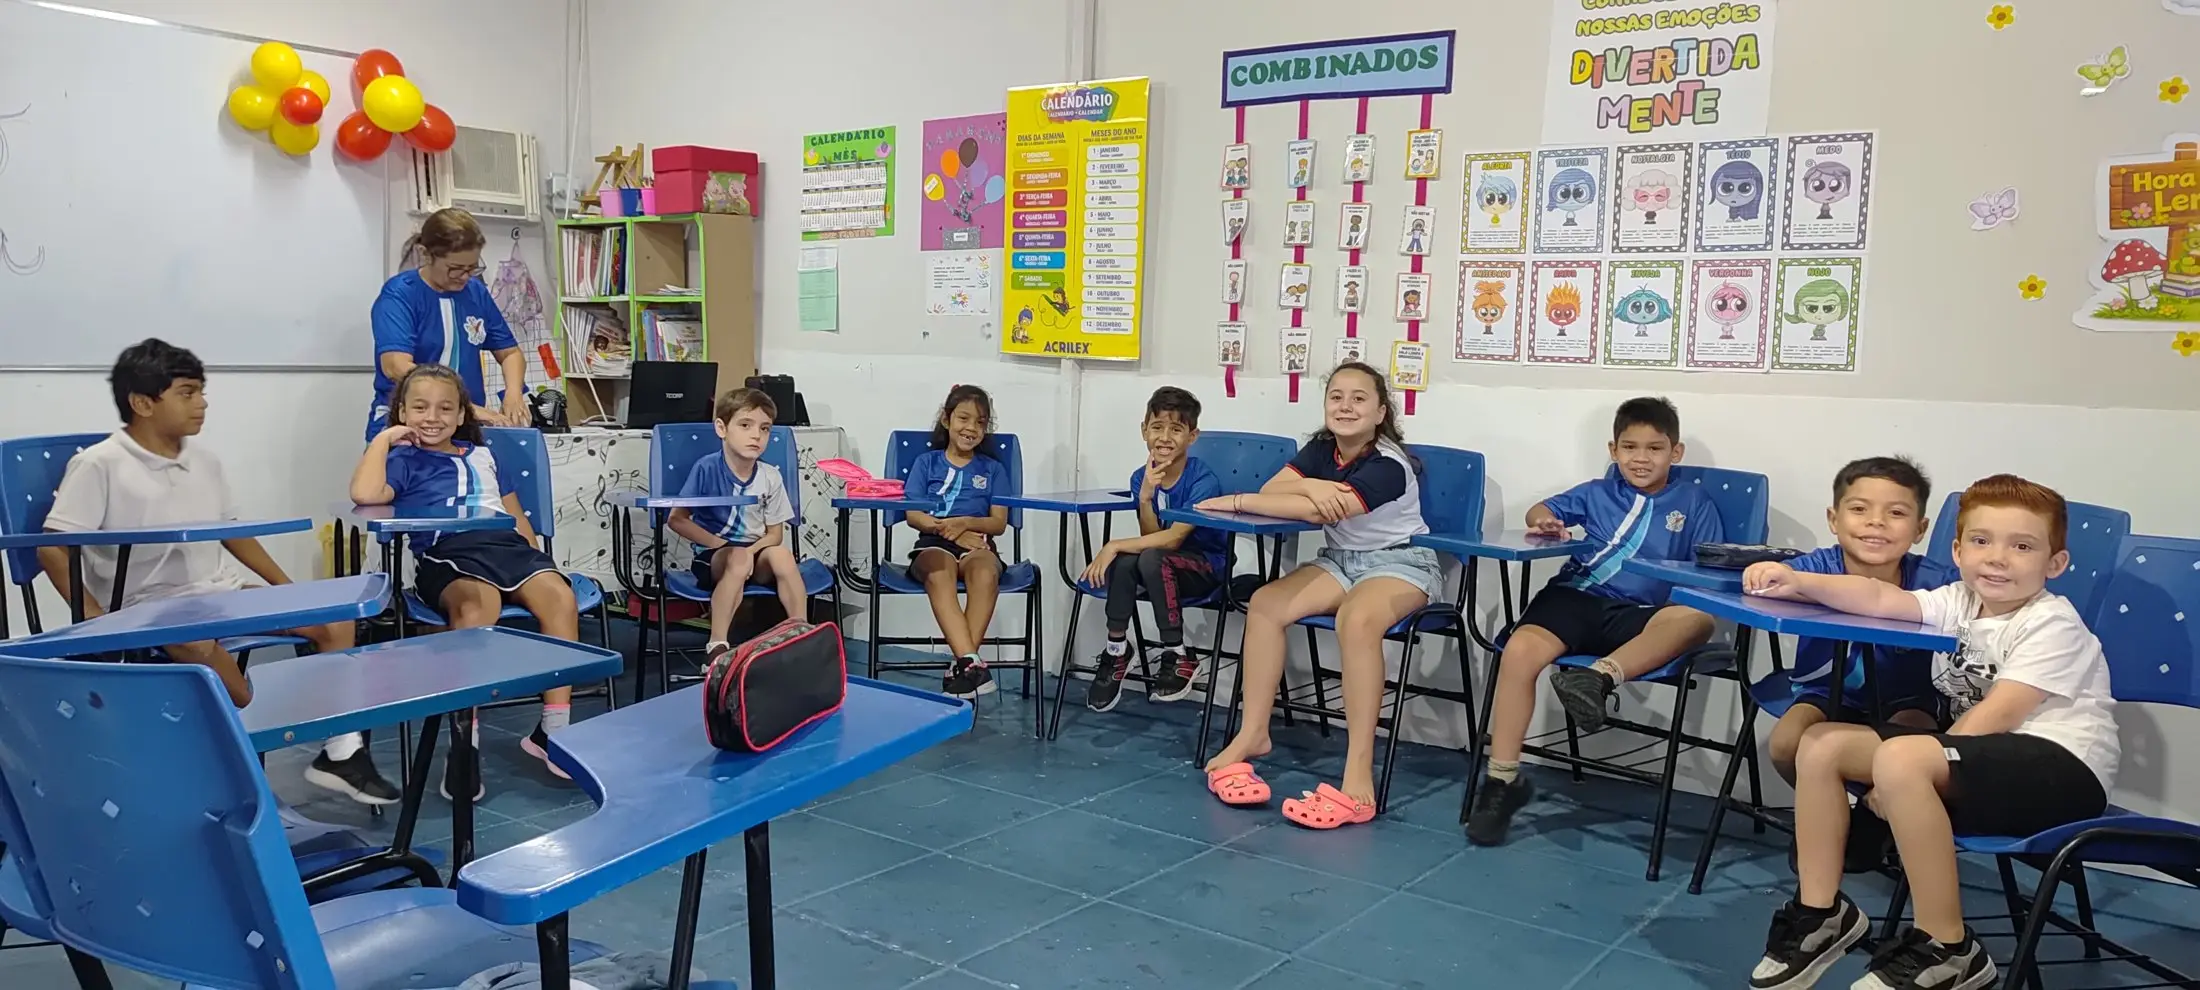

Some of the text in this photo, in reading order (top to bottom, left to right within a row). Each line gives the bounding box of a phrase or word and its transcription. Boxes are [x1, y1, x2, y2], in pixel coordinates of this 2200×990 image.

[1576, 4, 1760, 37] NOSSAS EMOÇÕES
[1230, 44, 1439, 87] COMBINADOS
[1570, 33, 1760, 89] DIVERTIDA
[1041, 91, 1113, 111] CALENDÁRIO
[1597, 80, 1721, 133] MENTE
[1078, 108, 1103, 116] CALENDAR
[1017, 132, 1065, 142] DIAS DA SEMANA
[1091, 127, 1137, 137] MESES DO ANO
[811, 129, 885, 147] CALENDÁRIO
[1726, 149, 1751, 160] TÉDIO
[1816, 145, 1842, 156] MEDO
[1555, 158, 1589, 167] TRISTEZA
[1631, 154, 1675, 164] NOSTALGIA
[1482, 161, 1513, 171] ALEGRIA
[2133, 171, 2196, 193] Hora
[1471, 269, 1511, 278] ANSIEDADE
[1709, 268, 1753, 278] VERGONHA
[1807, 268, 1832, 277] NOJO
[1044, 341, 1089, 354] ACRILEX
